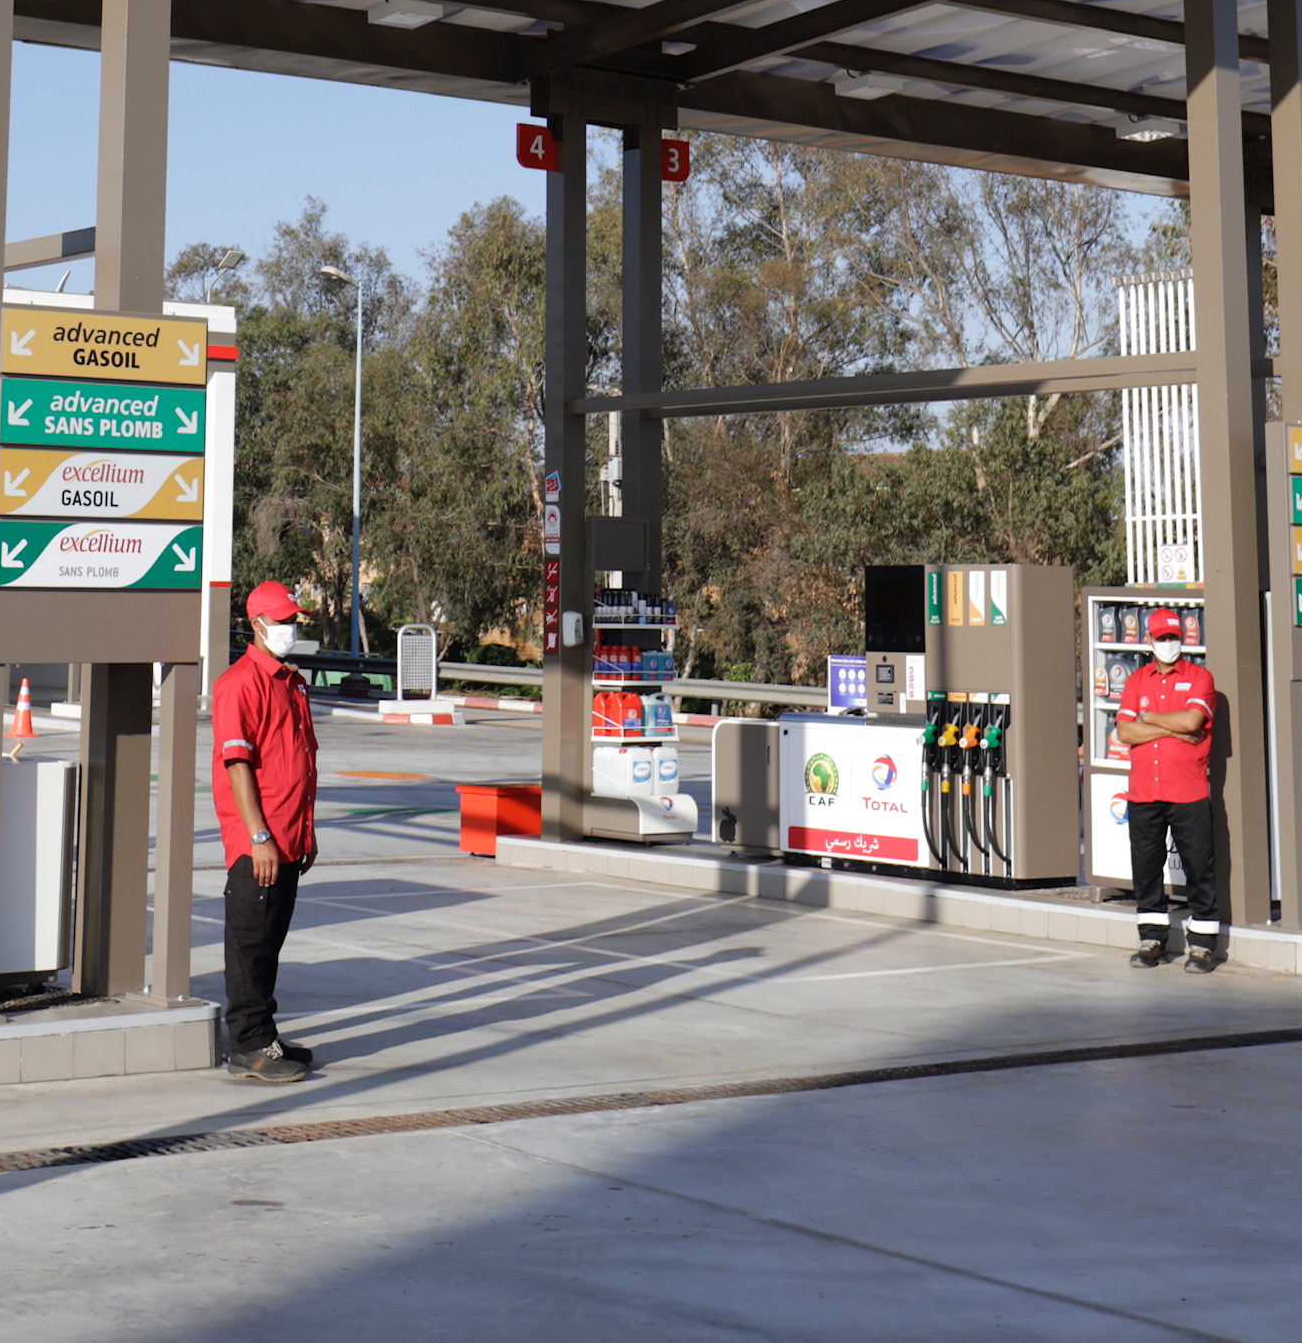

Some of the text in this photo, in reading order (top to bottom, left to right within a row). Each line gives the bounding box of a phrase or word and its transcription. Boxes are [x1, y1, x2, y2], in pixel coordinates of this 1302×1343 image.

[529, 135, 545, 160] 4
[668, 147, 680, 173] 3
[53, 322, 161, 348] advanced
[73, 348, 140, 369] GASOIL
[50, 390, 159, 417] advanced
[44, 416, 163, 439] SANS PLOMB
[62, 462, 144, 484] excellium
[61, 489, 118, 507] GASOIL
[59, 531, 142, 554] excellium
[59, 566, 119, 578] SANS PLOMB
[809, 796, 835, 807] CAF
[862, 797, 908, 813] TOTAL
[825, 835, 879, 853] شريك رسمي
